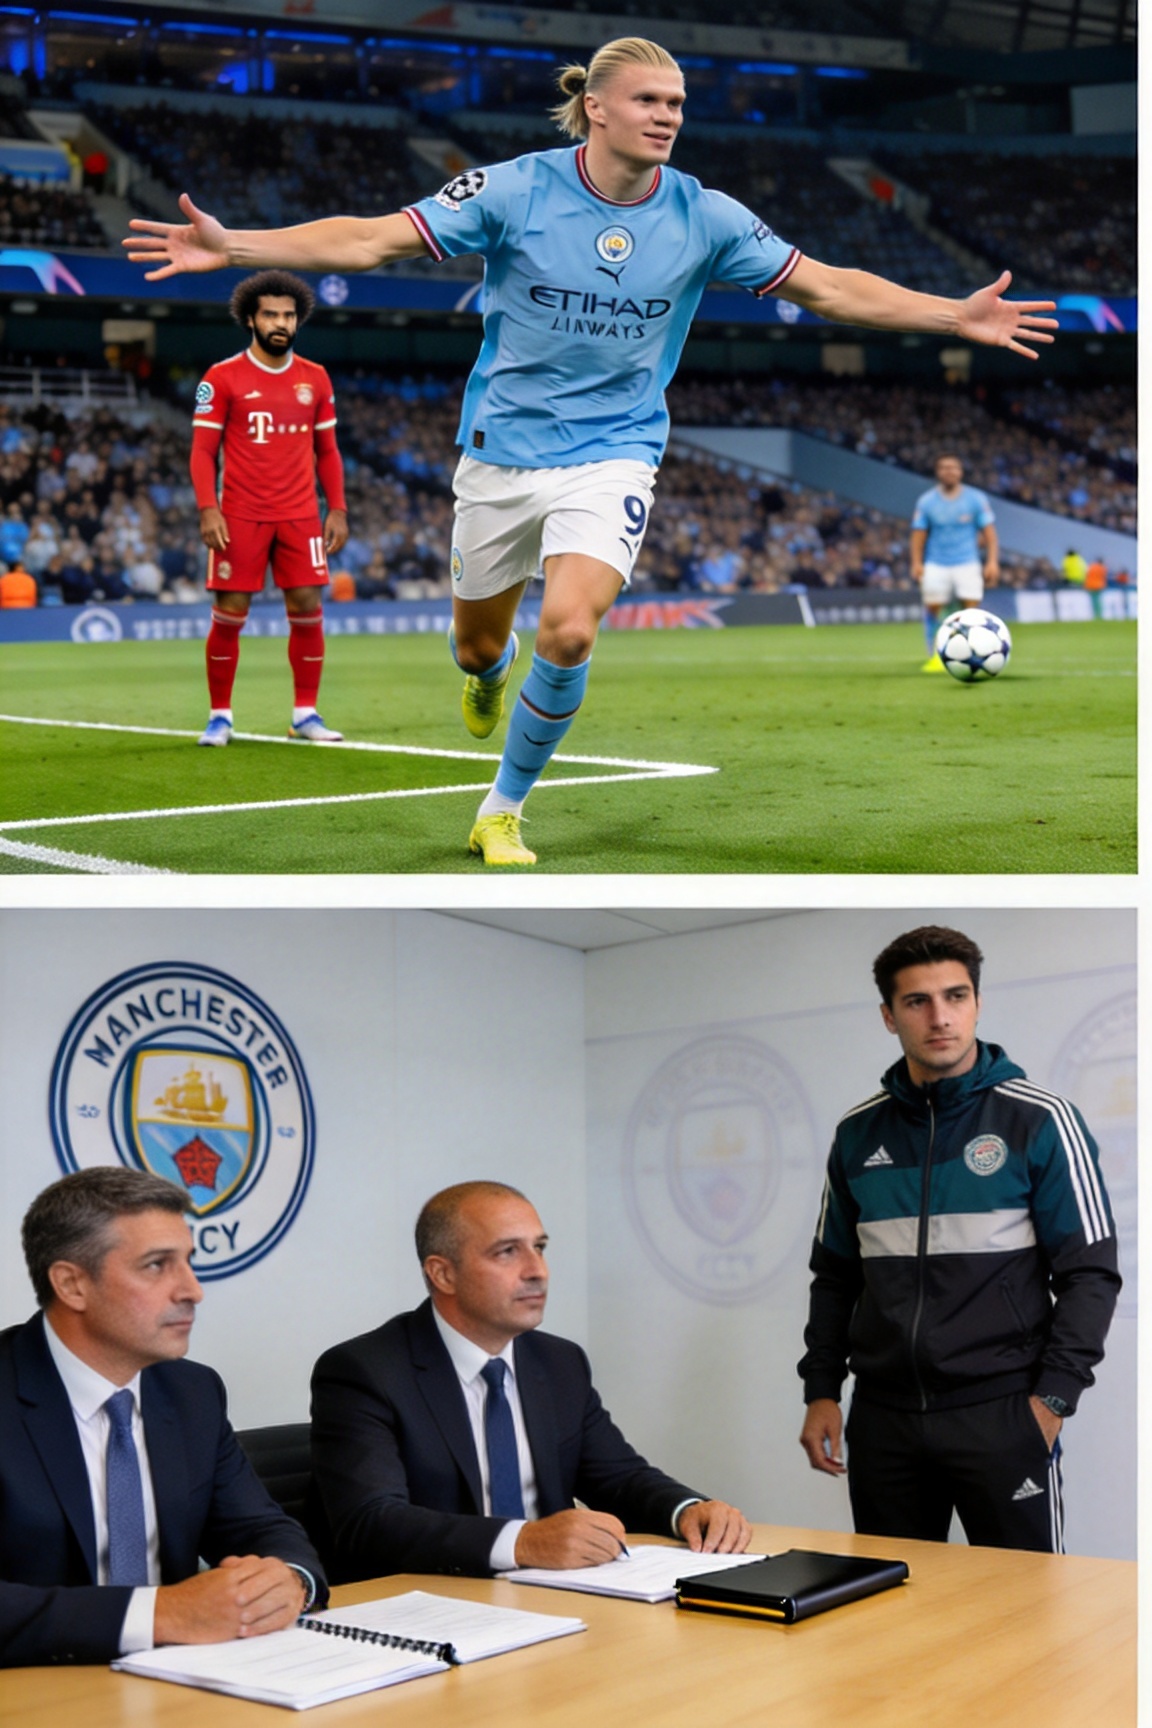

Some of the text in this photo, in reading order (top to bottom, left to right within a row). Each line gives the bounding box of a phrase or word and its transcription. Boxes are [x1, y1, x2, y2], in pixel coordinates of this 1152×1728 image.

[530, 285, 671, 320] ETIHAD
[623, 494, 647, 536] 9
[83, 988, 288, 1090] MANCHESTER
[189, 1221, 240, 1257] CY
